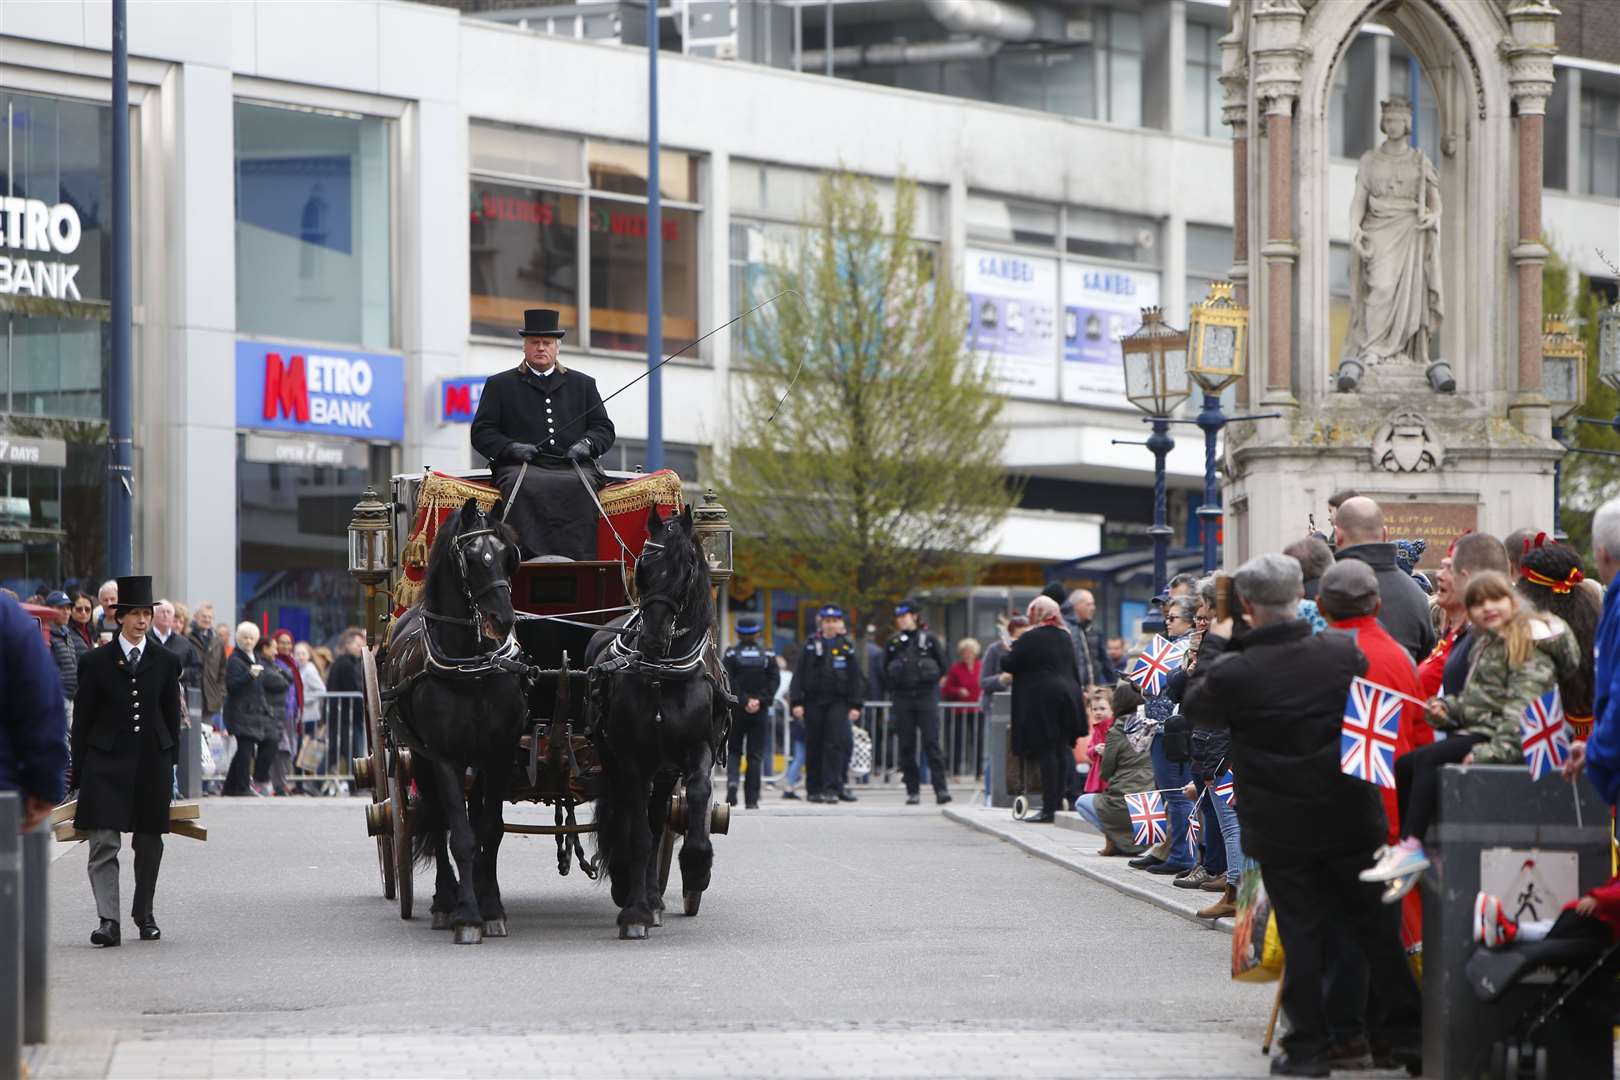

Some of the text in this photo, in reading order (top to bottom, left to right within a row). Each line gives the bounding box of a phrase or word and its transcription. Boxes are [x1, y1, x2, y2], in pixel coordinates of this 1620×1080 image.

[263, 352, 373, 424] METRO
[311, 397, 373, 429] BANK
[11, 446, 40, 462] DAYS
